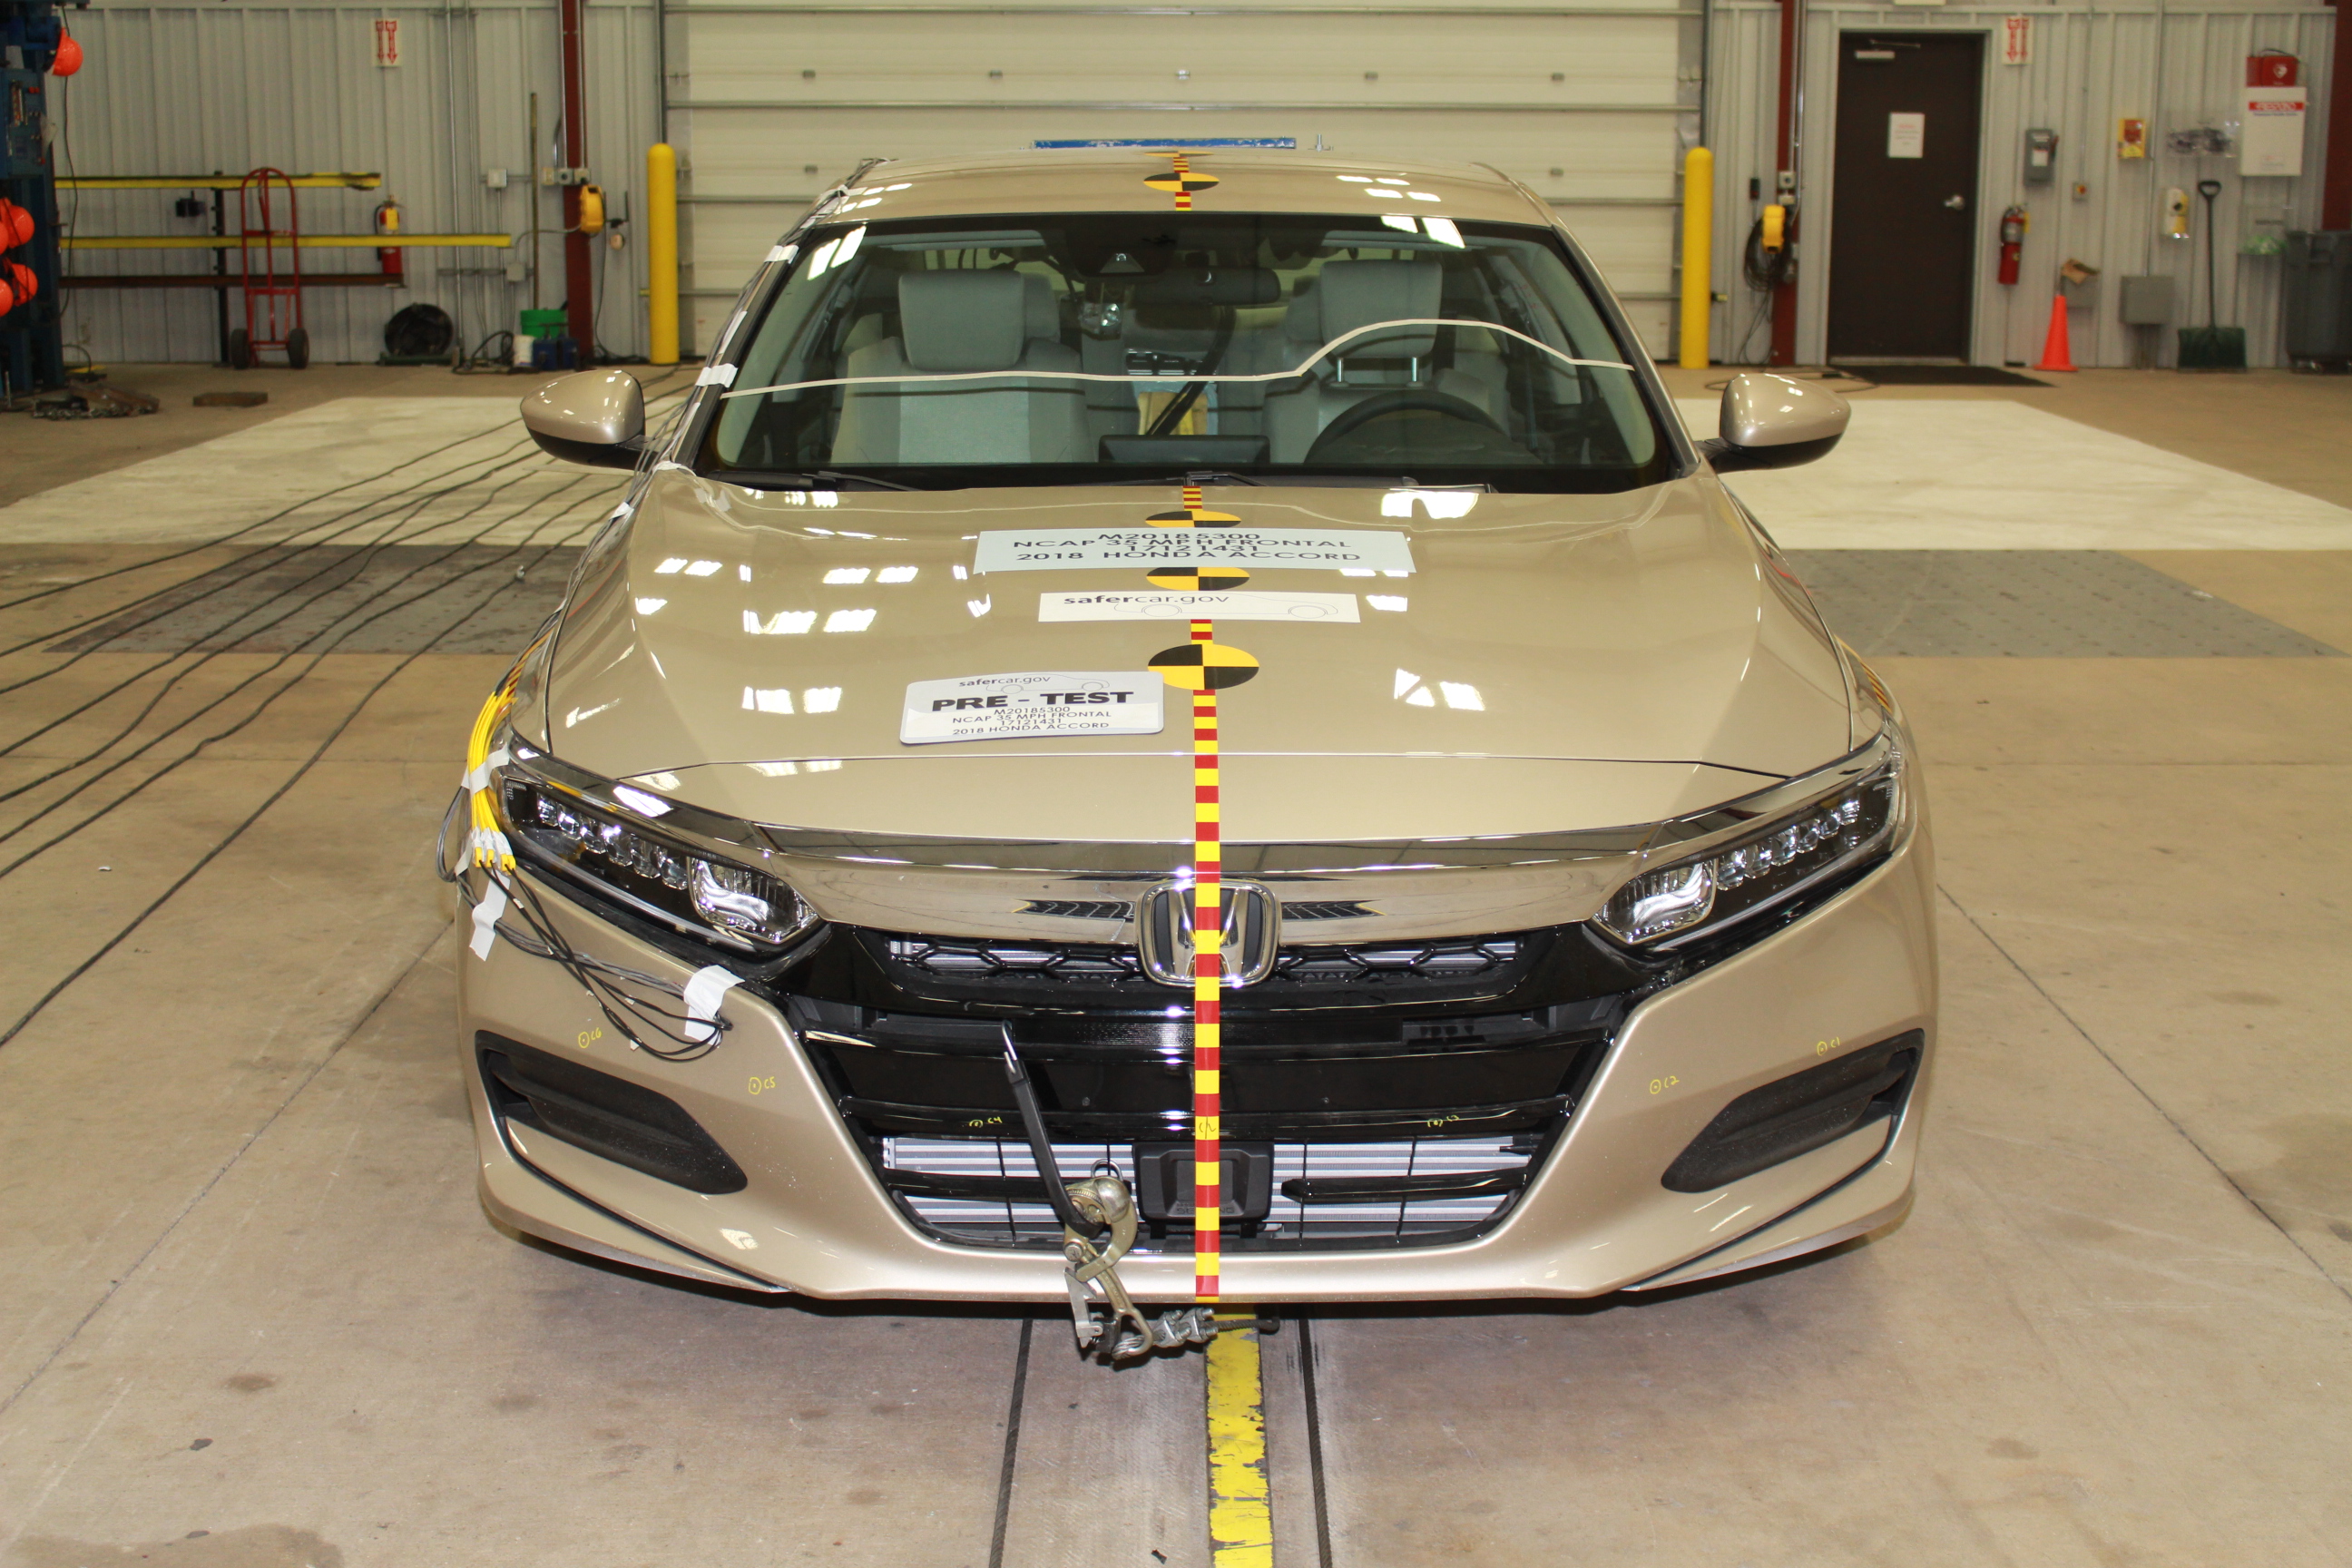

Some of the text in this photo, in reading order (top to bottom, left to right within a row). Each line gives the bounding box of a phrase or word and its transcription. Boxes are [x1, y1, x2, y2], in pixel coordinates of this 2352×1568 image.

[1225, 539, 1352, 548] FRONTAL
[1229, 552, 1360, 561] ACCORD
[1064, 595, 1230, 604] safercar.gov
[959, 677, 1051, 687] safercar.gov
[932, 695, 1008, 711] PRE
[1040, 691, 1134, 705] TEST
[994, 706, 1071, 715] M20185300
[952, 715, 992, 723] NCAP
[1001, 718, 1062, 726] 17121431
[953, 727, 984, 735] 2018
[989, 724, 1041, 732] HONDA
